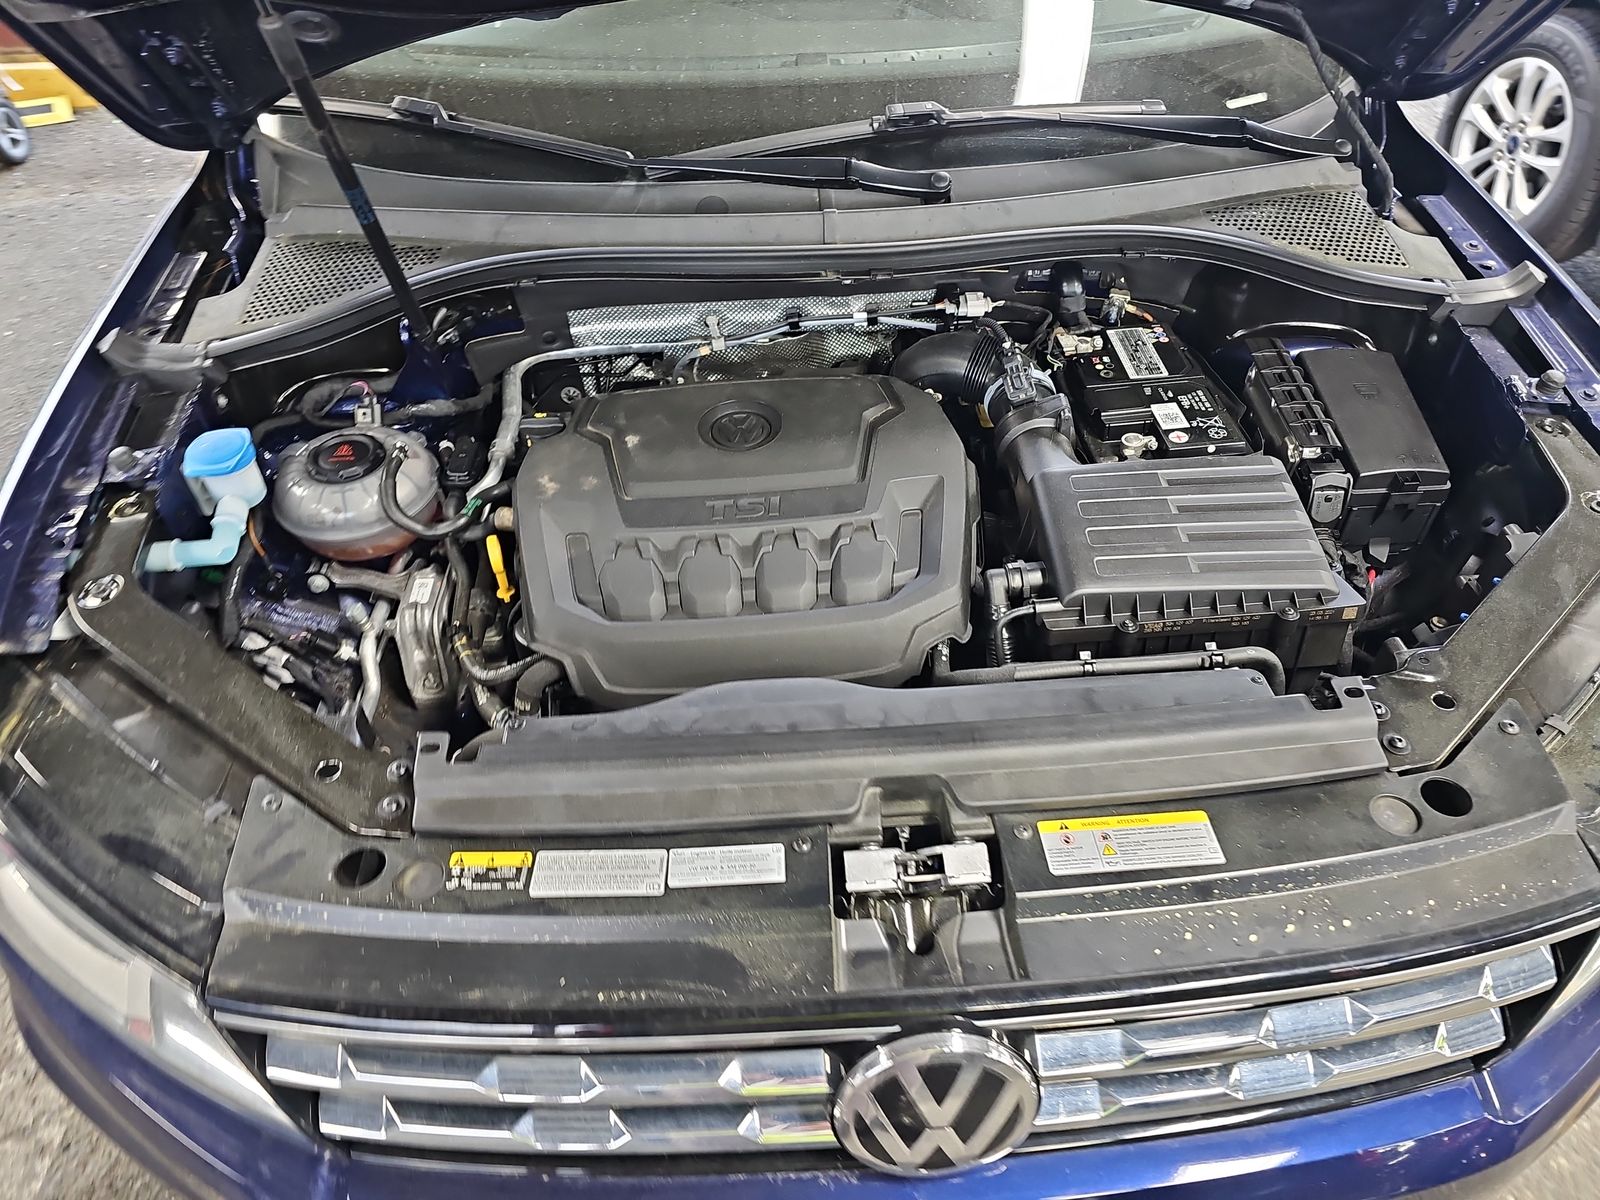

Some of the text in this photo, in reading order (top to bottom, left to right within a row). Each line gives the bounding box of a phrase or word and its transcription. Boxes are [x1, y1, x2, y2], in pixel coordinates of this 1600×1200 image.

[705, 496, 781, 520] TSI
[1080, 820, 1110, 828] WARNING
[842, 1050, 1028, 1170] VW
